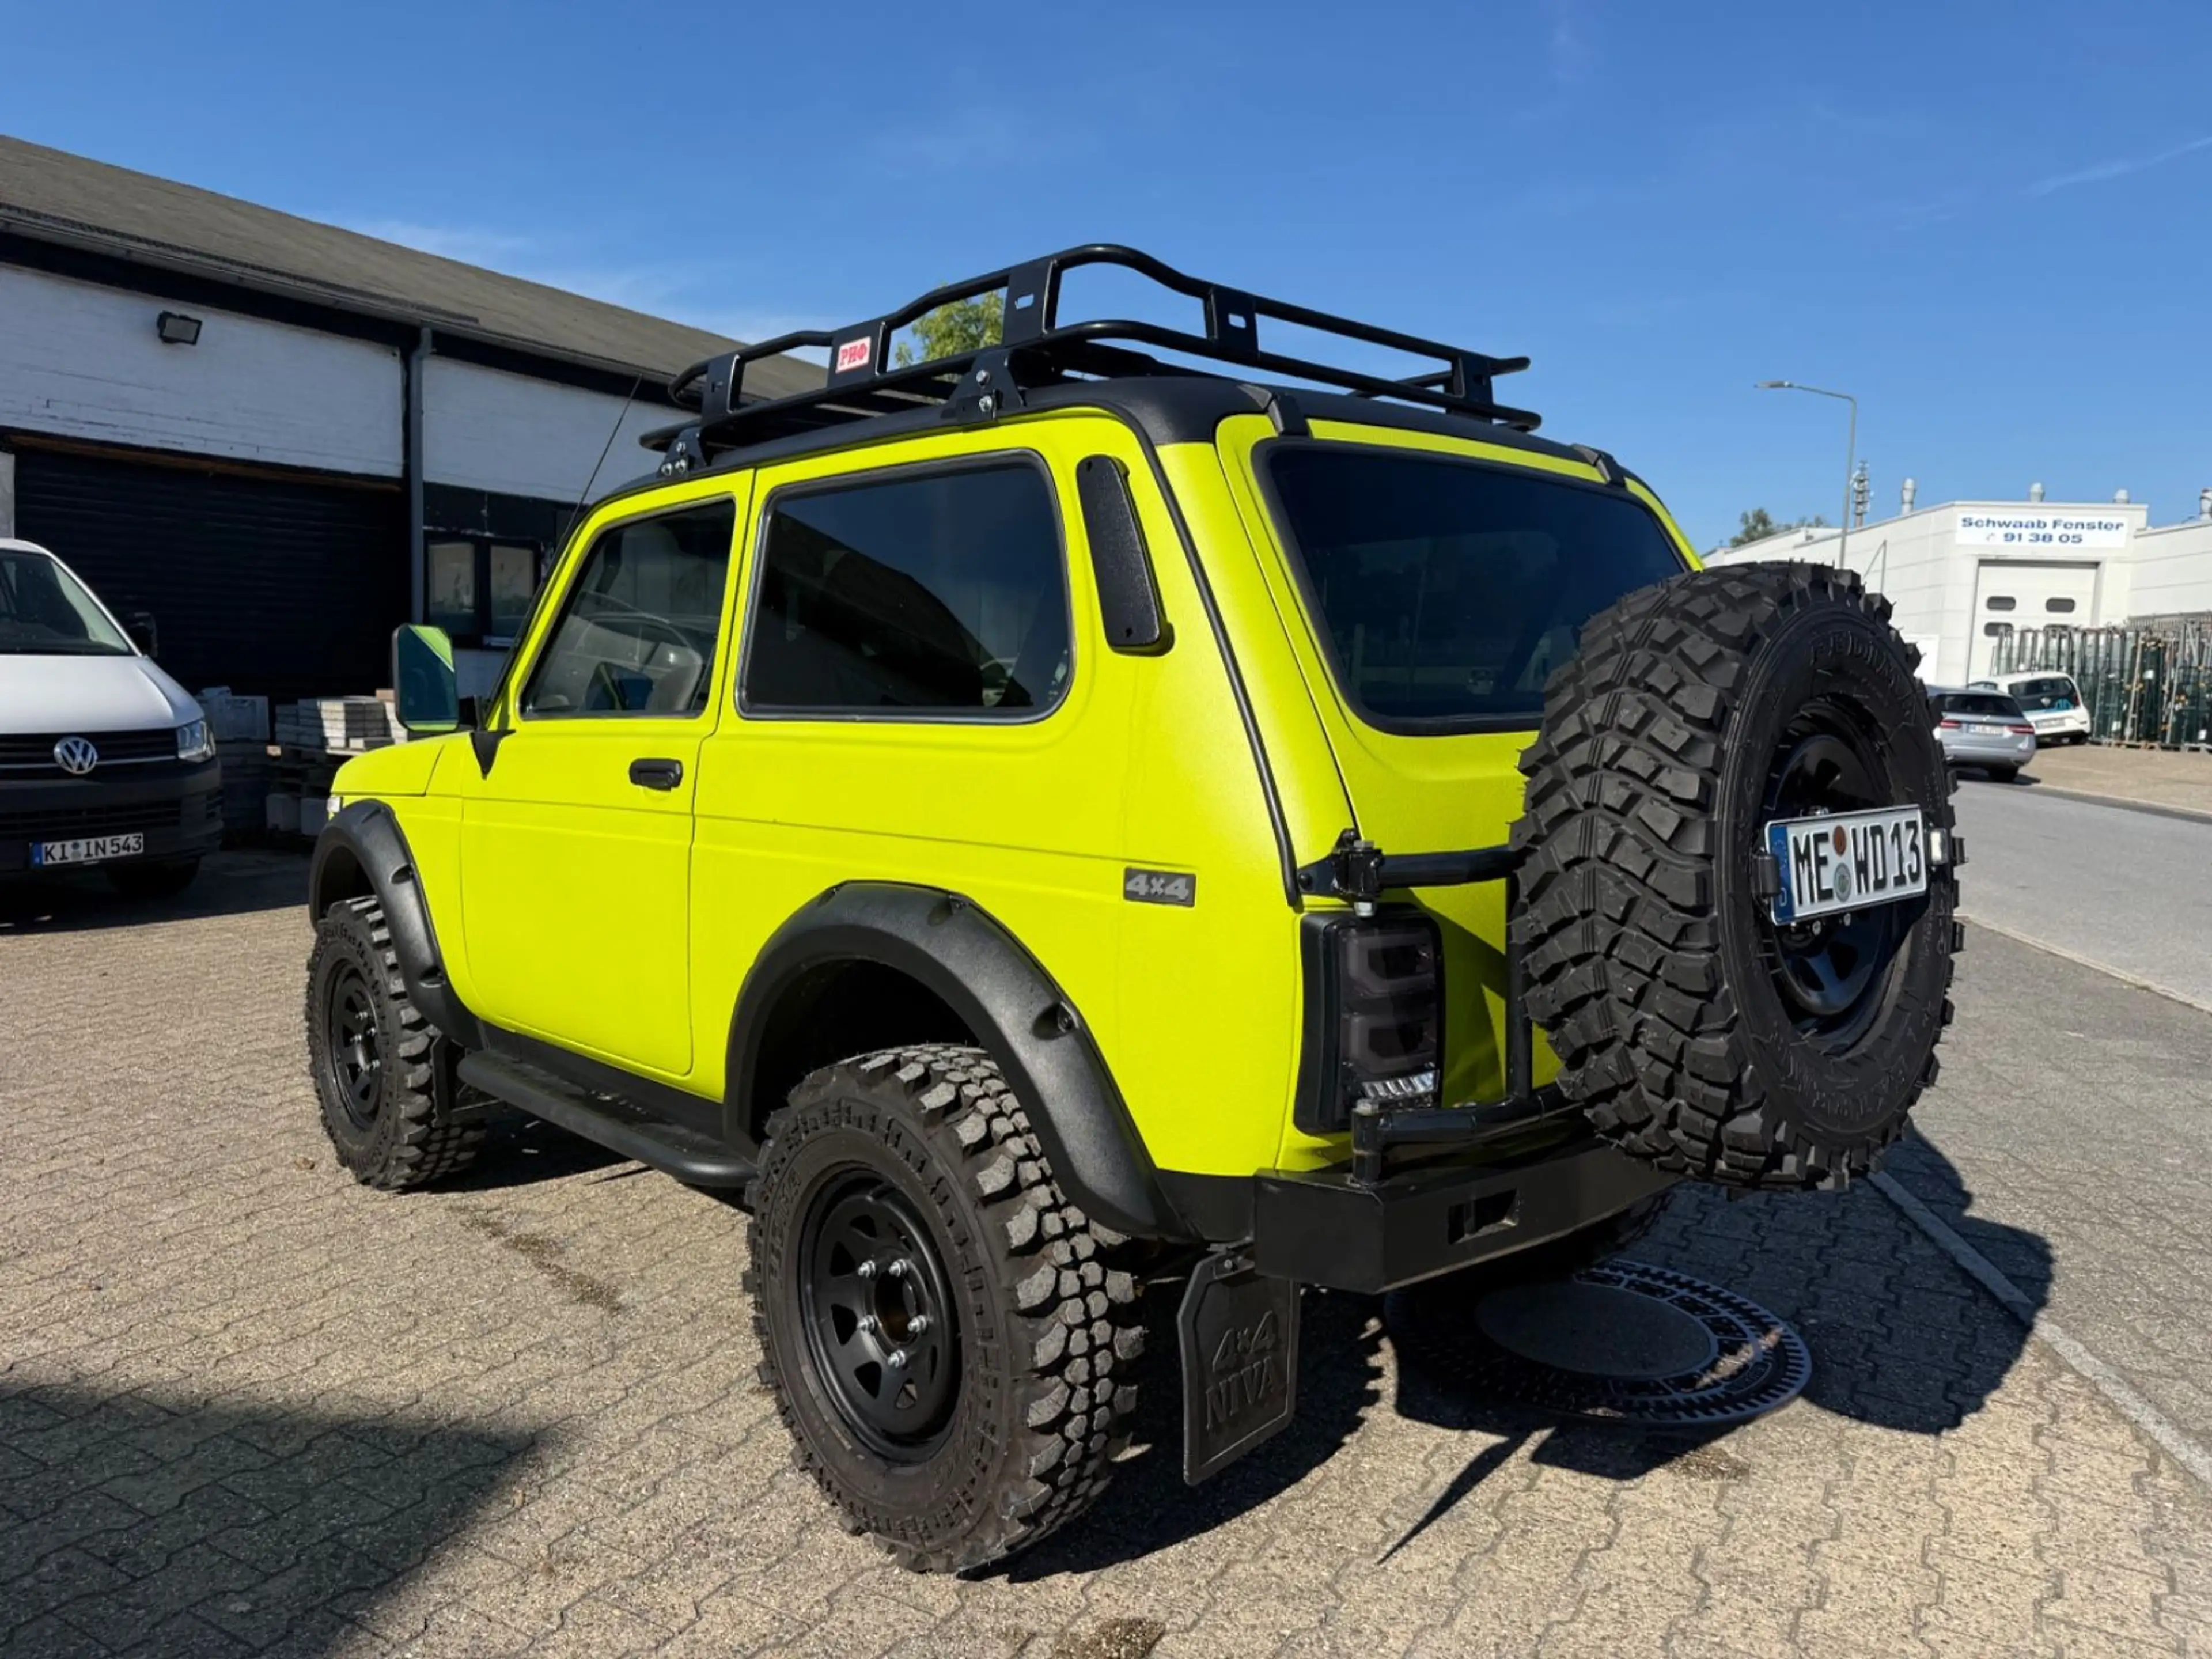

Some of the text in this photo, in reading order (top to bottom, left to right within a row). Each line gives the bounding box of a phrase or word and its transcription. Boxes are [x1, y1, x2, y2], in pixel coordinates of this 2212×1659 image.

[1961, 517, 2124, 531] Schwaab Fenster
[2003, 532, 2083, 543] 91 38 05
[44, 835, 142, 862] KI IN 543
[1793, 820, 1921, 907] ME WD 13
[1126, 874, 1188, 900] 4x4
[1206, 1355, 1277, 1431] NIVA
